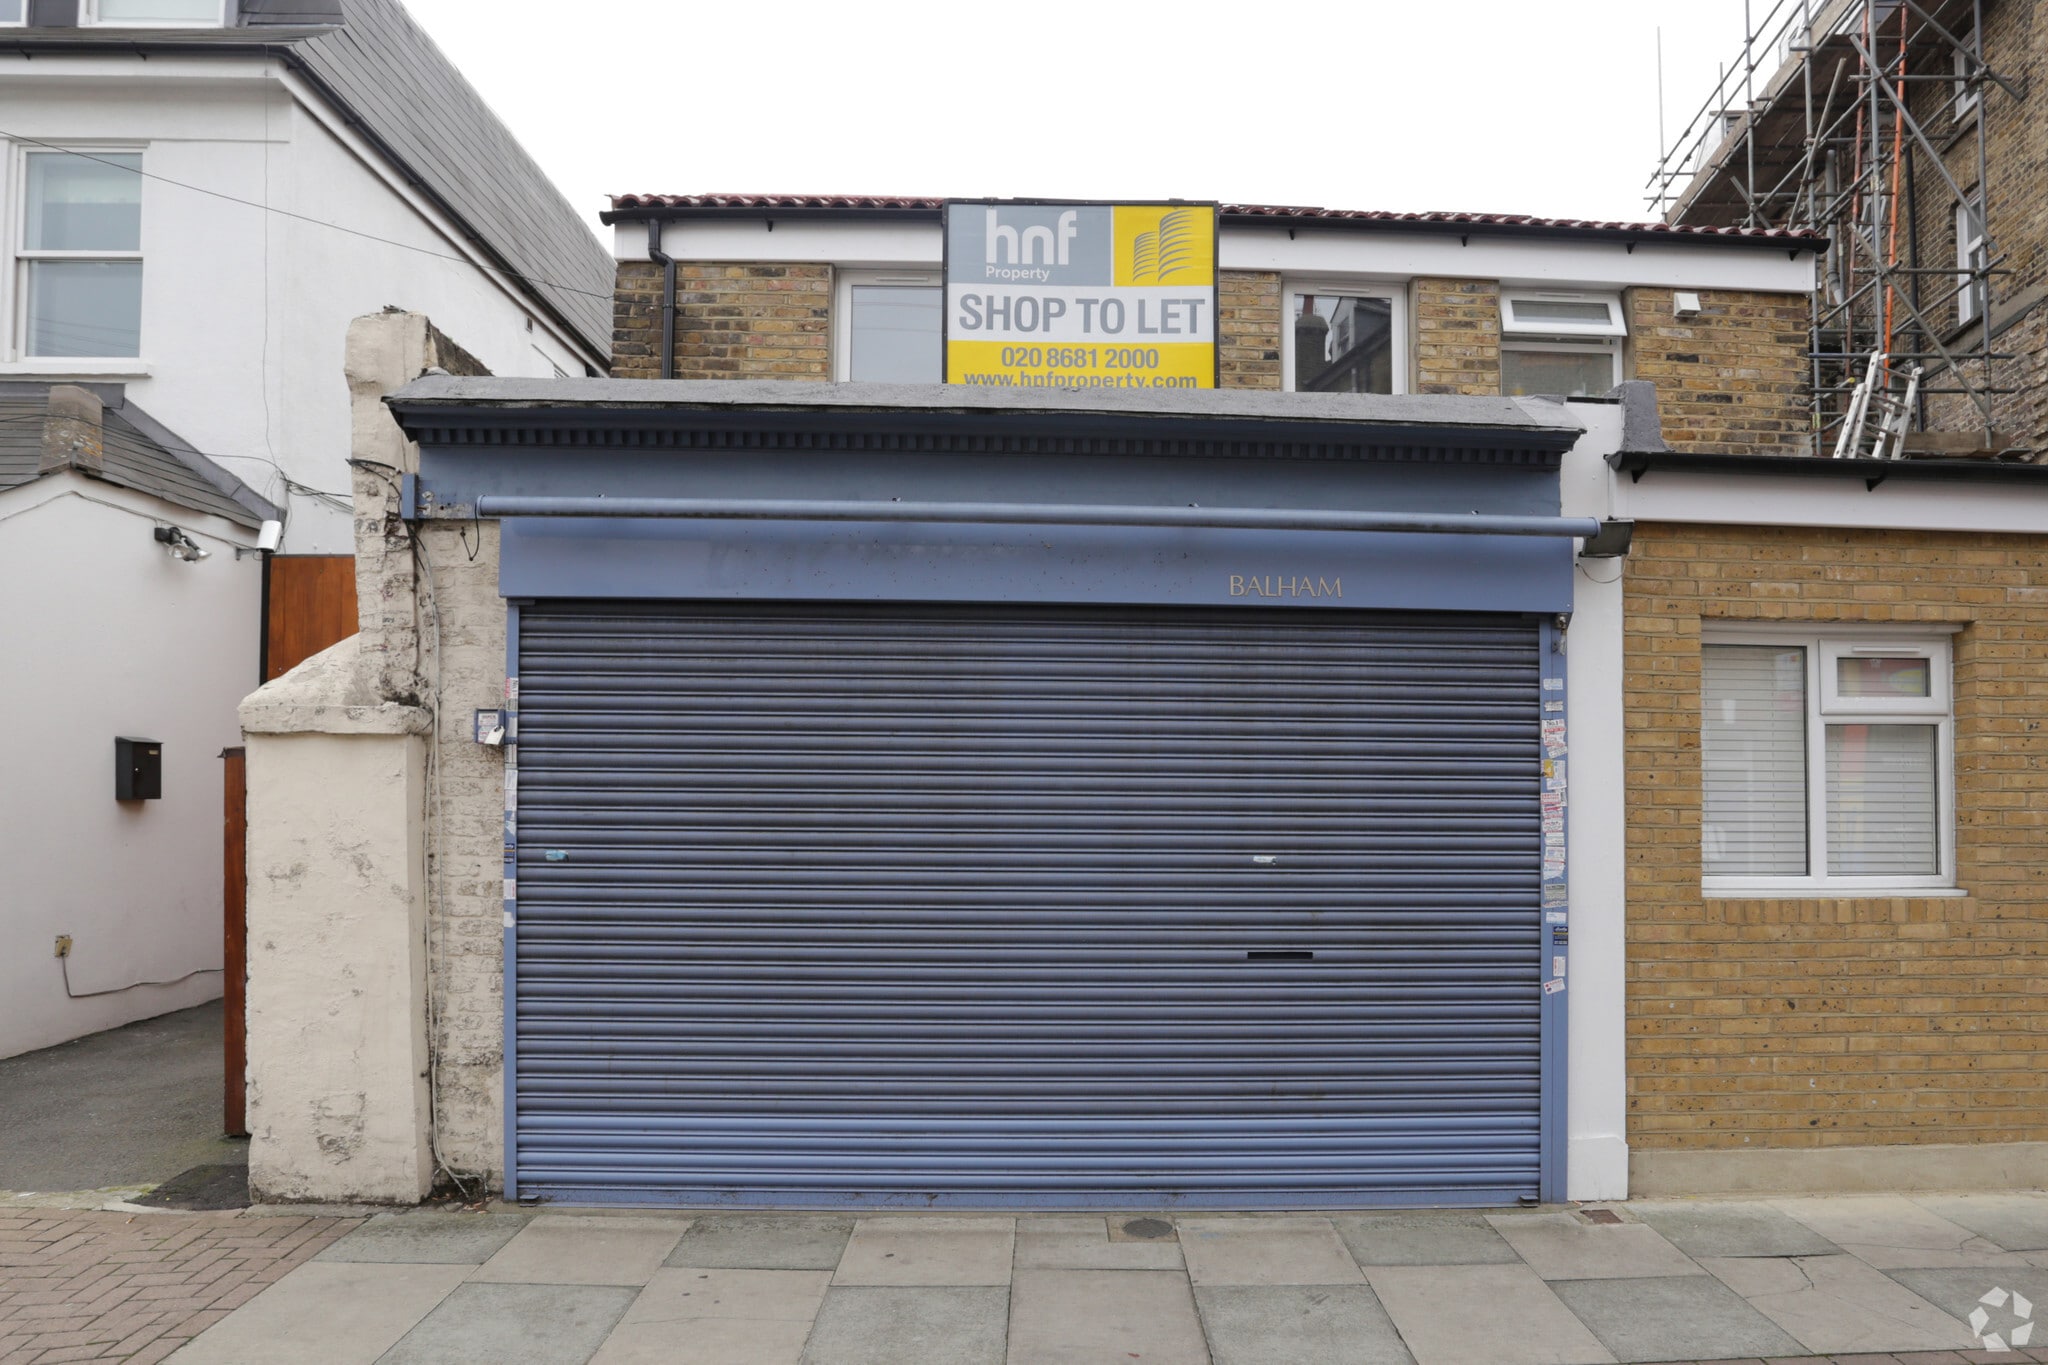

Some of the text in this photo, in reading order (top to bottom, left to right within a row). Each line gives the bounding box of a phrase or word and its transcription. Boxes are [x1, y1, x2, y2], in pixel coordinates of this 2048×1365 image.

[986, 209, 1077, 265] hnf
[985, 266, 1050, 282] Property
[959, 293, 1205, 334] SHOP TO LET
[1001, 346, 1159, 369] 020 8681 2000
[964, 370, 1197, 388] www.hnfproperty.com
[1229, 575, 1342, 598] BALHAM
